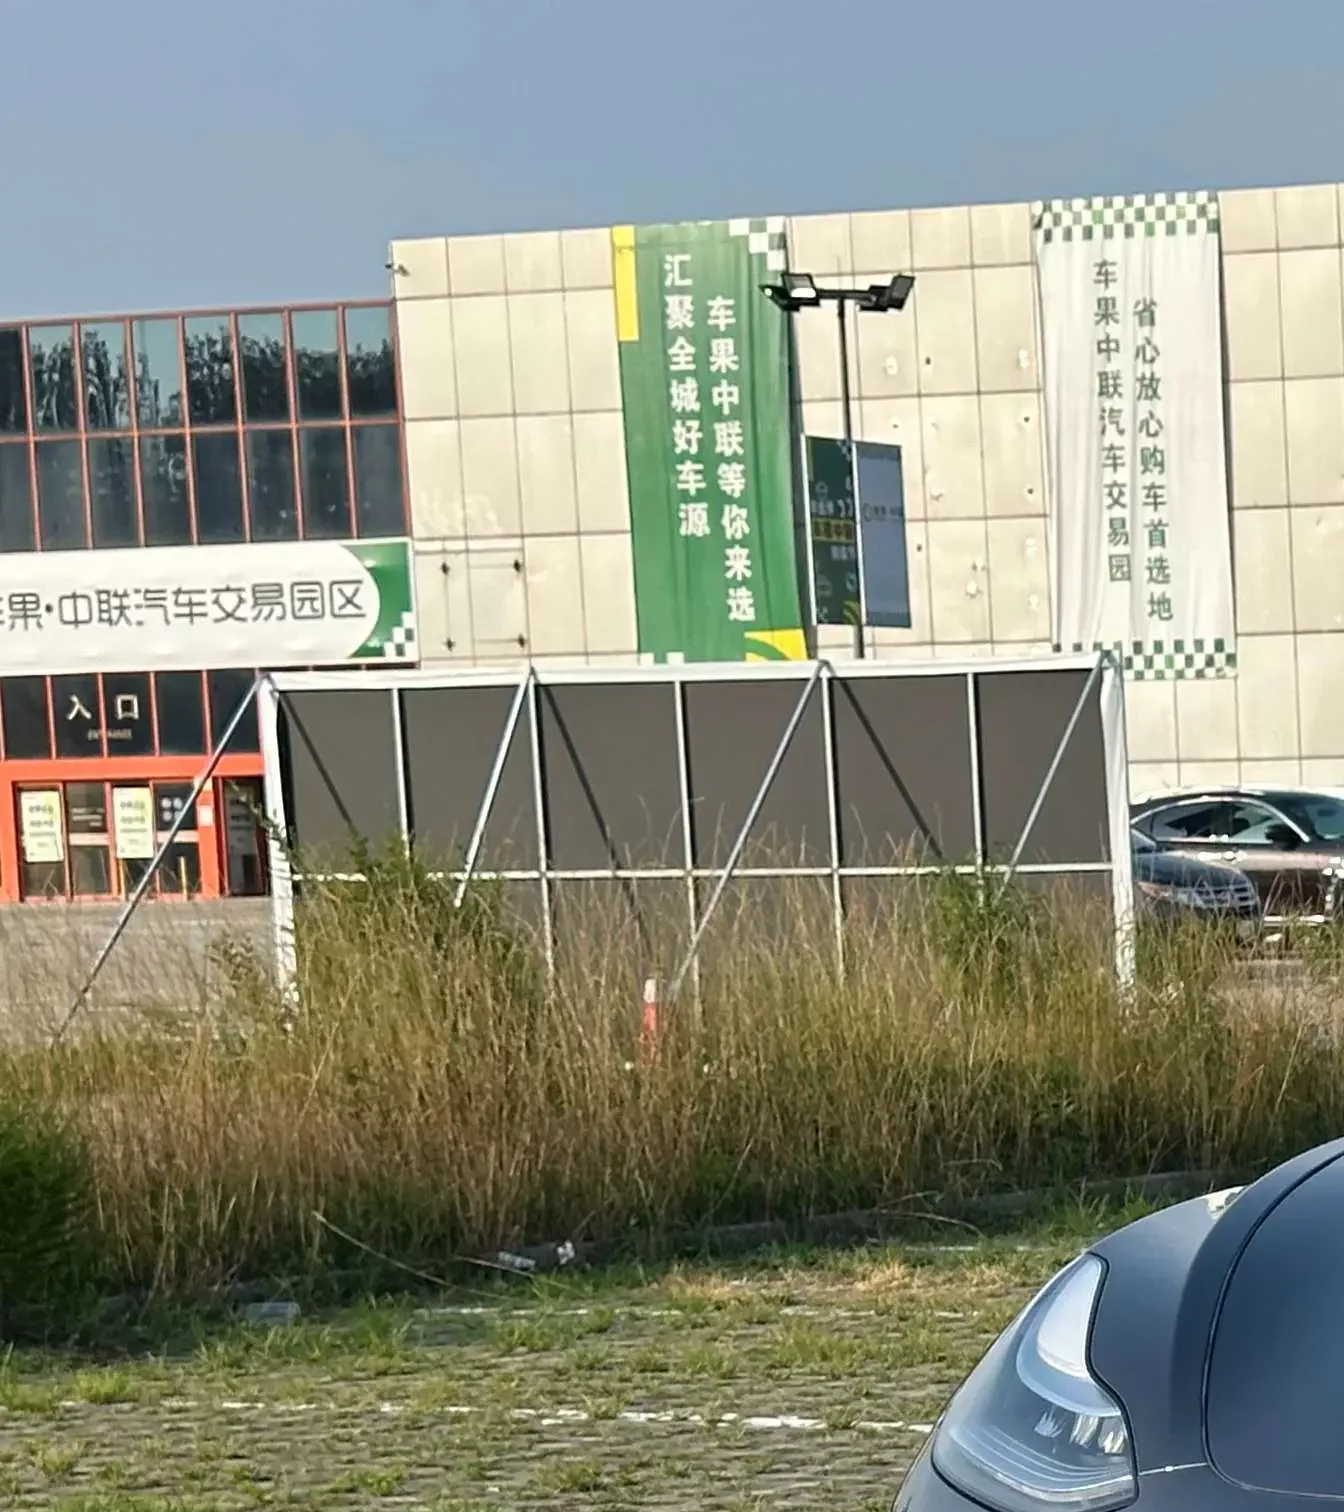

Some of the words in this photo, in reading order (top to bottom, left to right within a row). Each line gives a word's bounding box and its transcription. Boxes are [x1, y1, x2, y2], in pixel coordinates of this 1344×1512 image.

[664, 253, 710, 538] 汇聚全城好车源
[706, 296, 755, 622] 车果中联等你来选
[1092, 259, 1132, 583] 车果中联汽车交易园
[1133, 299, 1173, 622] 省心放心购车首选地
[0, 579, 366, 632] 果·中联汽车交易园区
[67, 694, 139, 720] 入口
